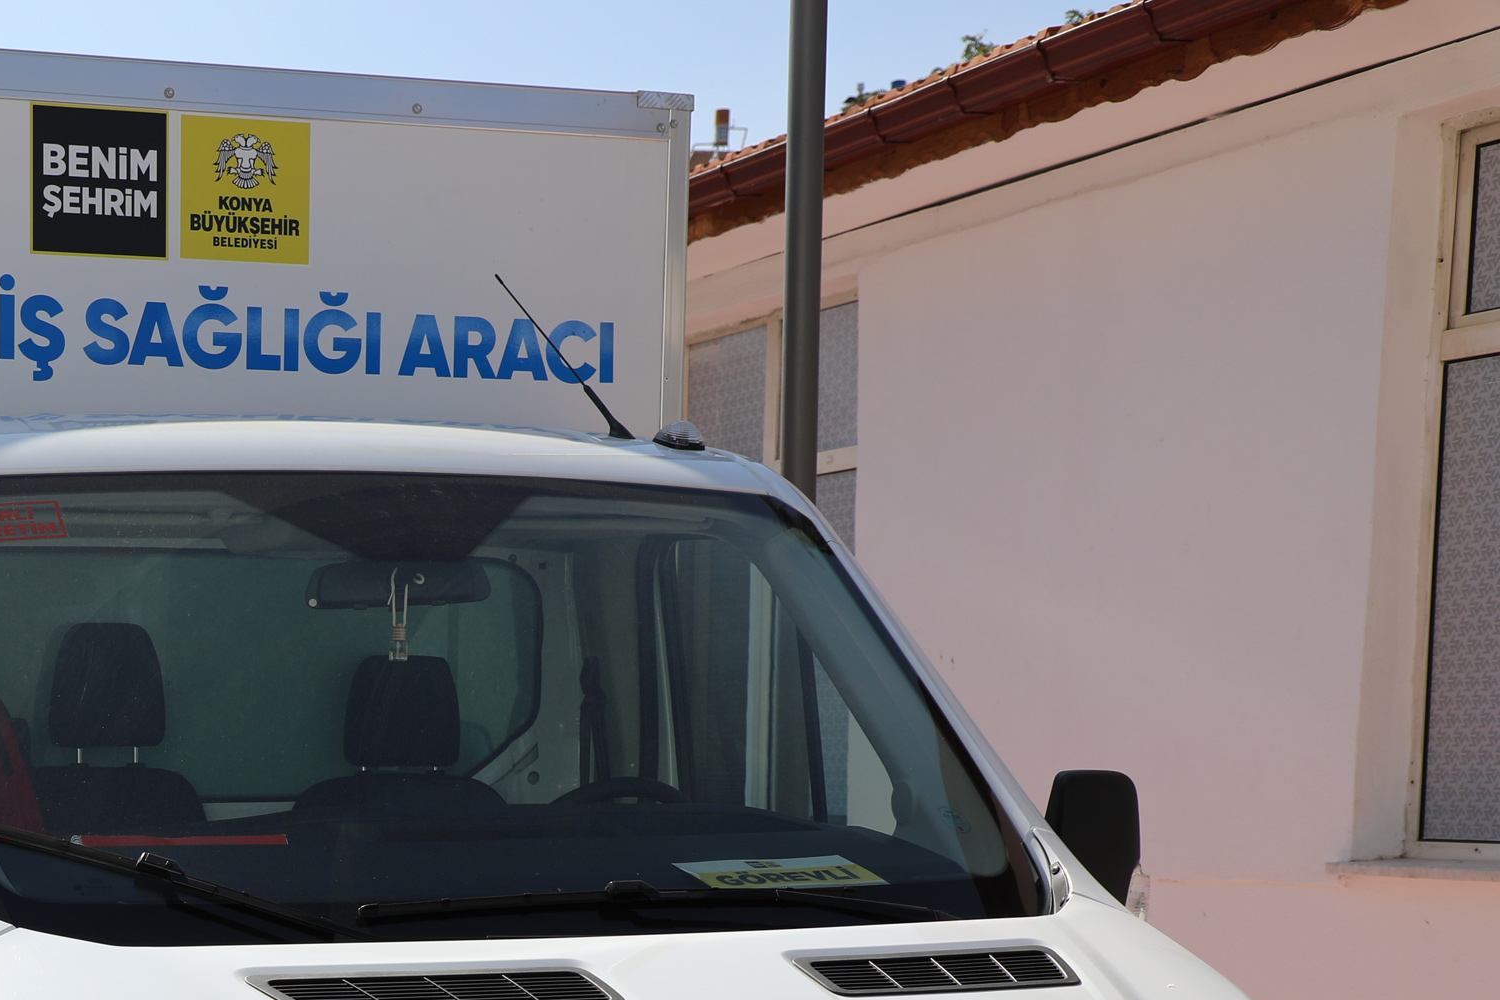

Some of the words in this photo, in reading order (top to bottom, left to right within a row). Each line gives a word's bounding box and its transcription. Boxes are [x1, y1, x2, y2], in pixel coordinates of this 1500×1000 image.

[218, 195, 273, 213] KONYA
[190, 211, 300, 236] BÜYÜKŞEHİR
[212, 236, 278, 250] BELEDİYESİ
[83, 285, 382, 377] SAĞLIĞI
[398, 312, 615, 384] ARACI
[716, 866, 861, 887] GÖREVLİ
